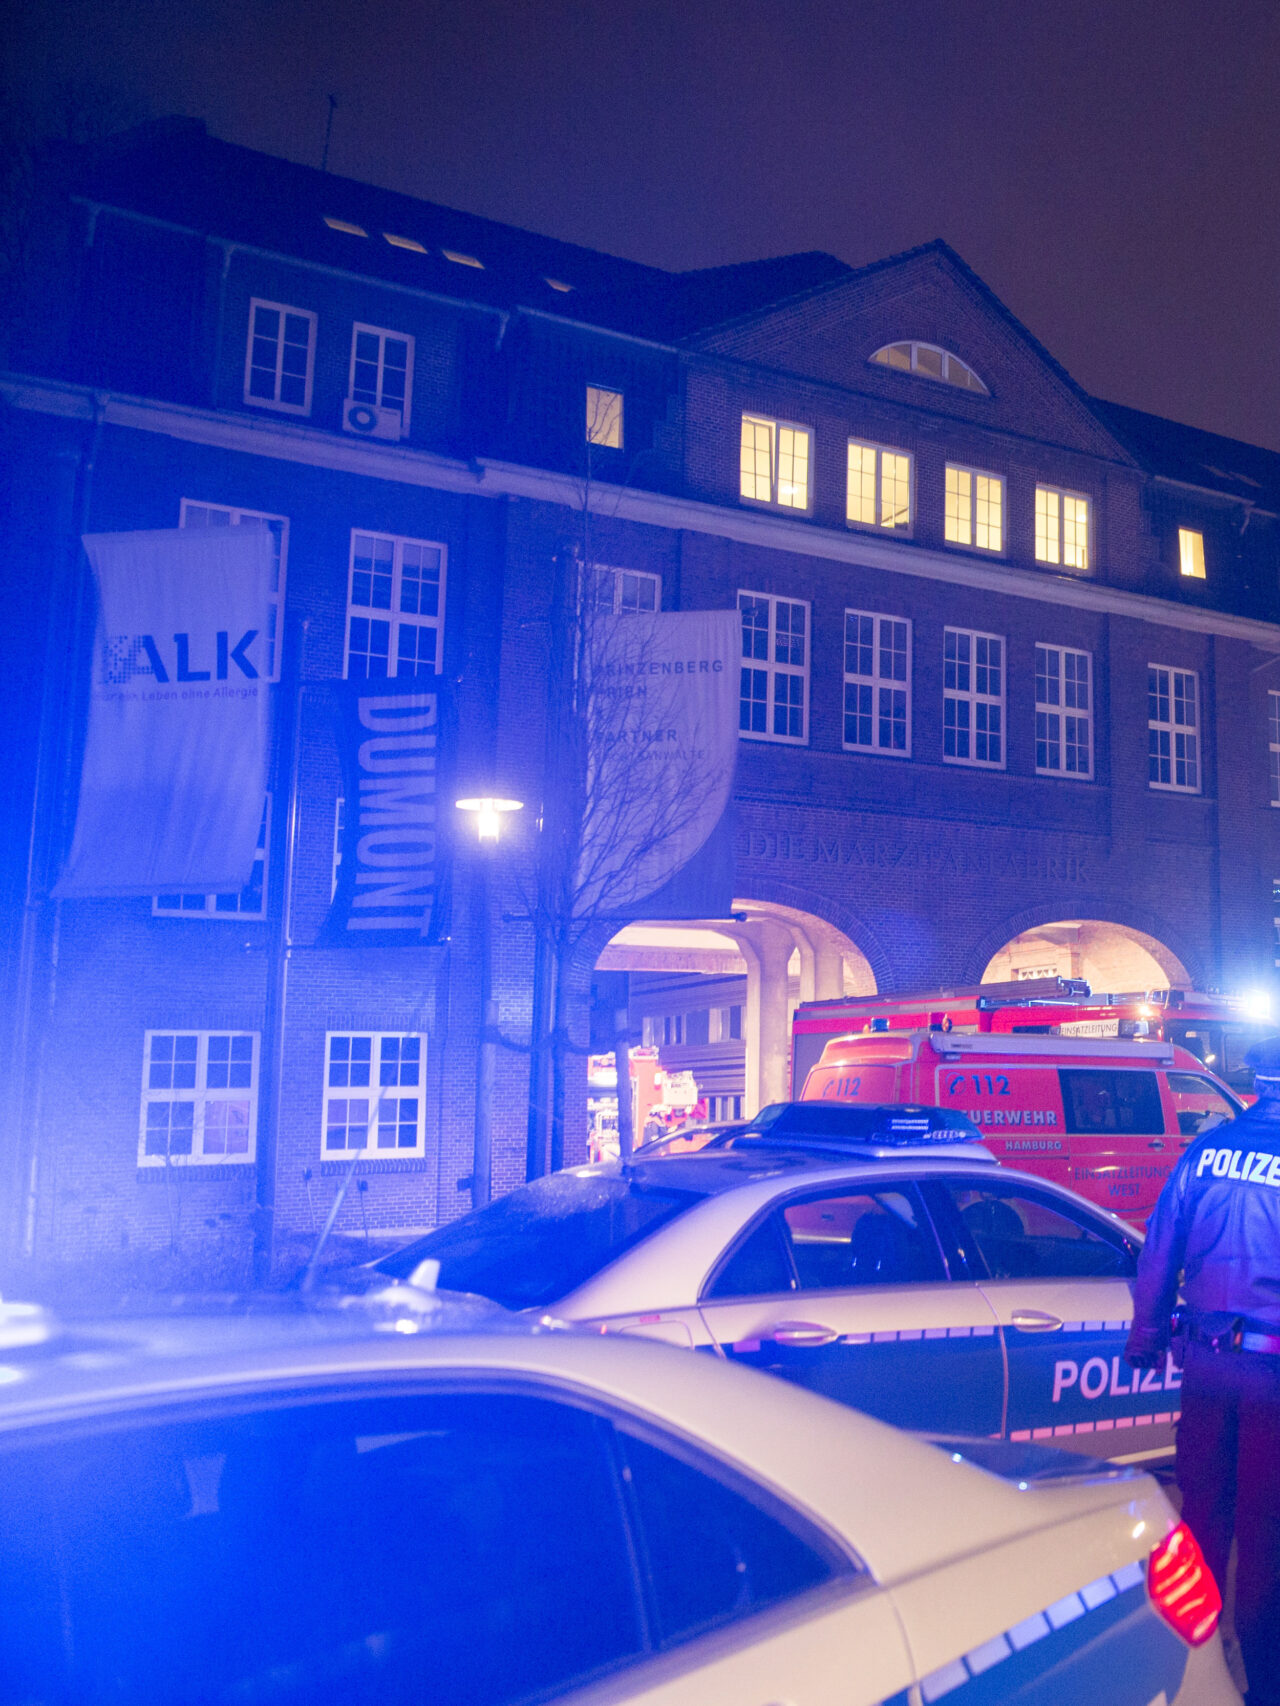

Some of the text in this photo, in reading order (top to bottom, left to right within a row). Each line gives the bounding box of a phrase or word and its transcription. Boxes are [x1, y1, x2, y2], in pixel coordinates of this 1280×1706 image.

[102, 630, 259, 683] ALK
[142, 690, 178, 701] Leben
[181, 687, 210, 699] ohne
[213, 686, 258, 699] Allergie
[347, 693, 437, 937] DUMONT
[748, 831, 805, 862] DIE
[1062, 1023, 1117, 1036] EINSATZLEITUNG
[836, 1078, 861, 1097] 112
[972, 1075, 1011, 1096] 112
[963, 1110, 1057, 1126] UERWEHR
[1005, 1140, 1062, 1151] HAMBURG
[1108, 1183, 1140, 1197] WEST
[1052, 1351, 1184, 1403] POLIZE
